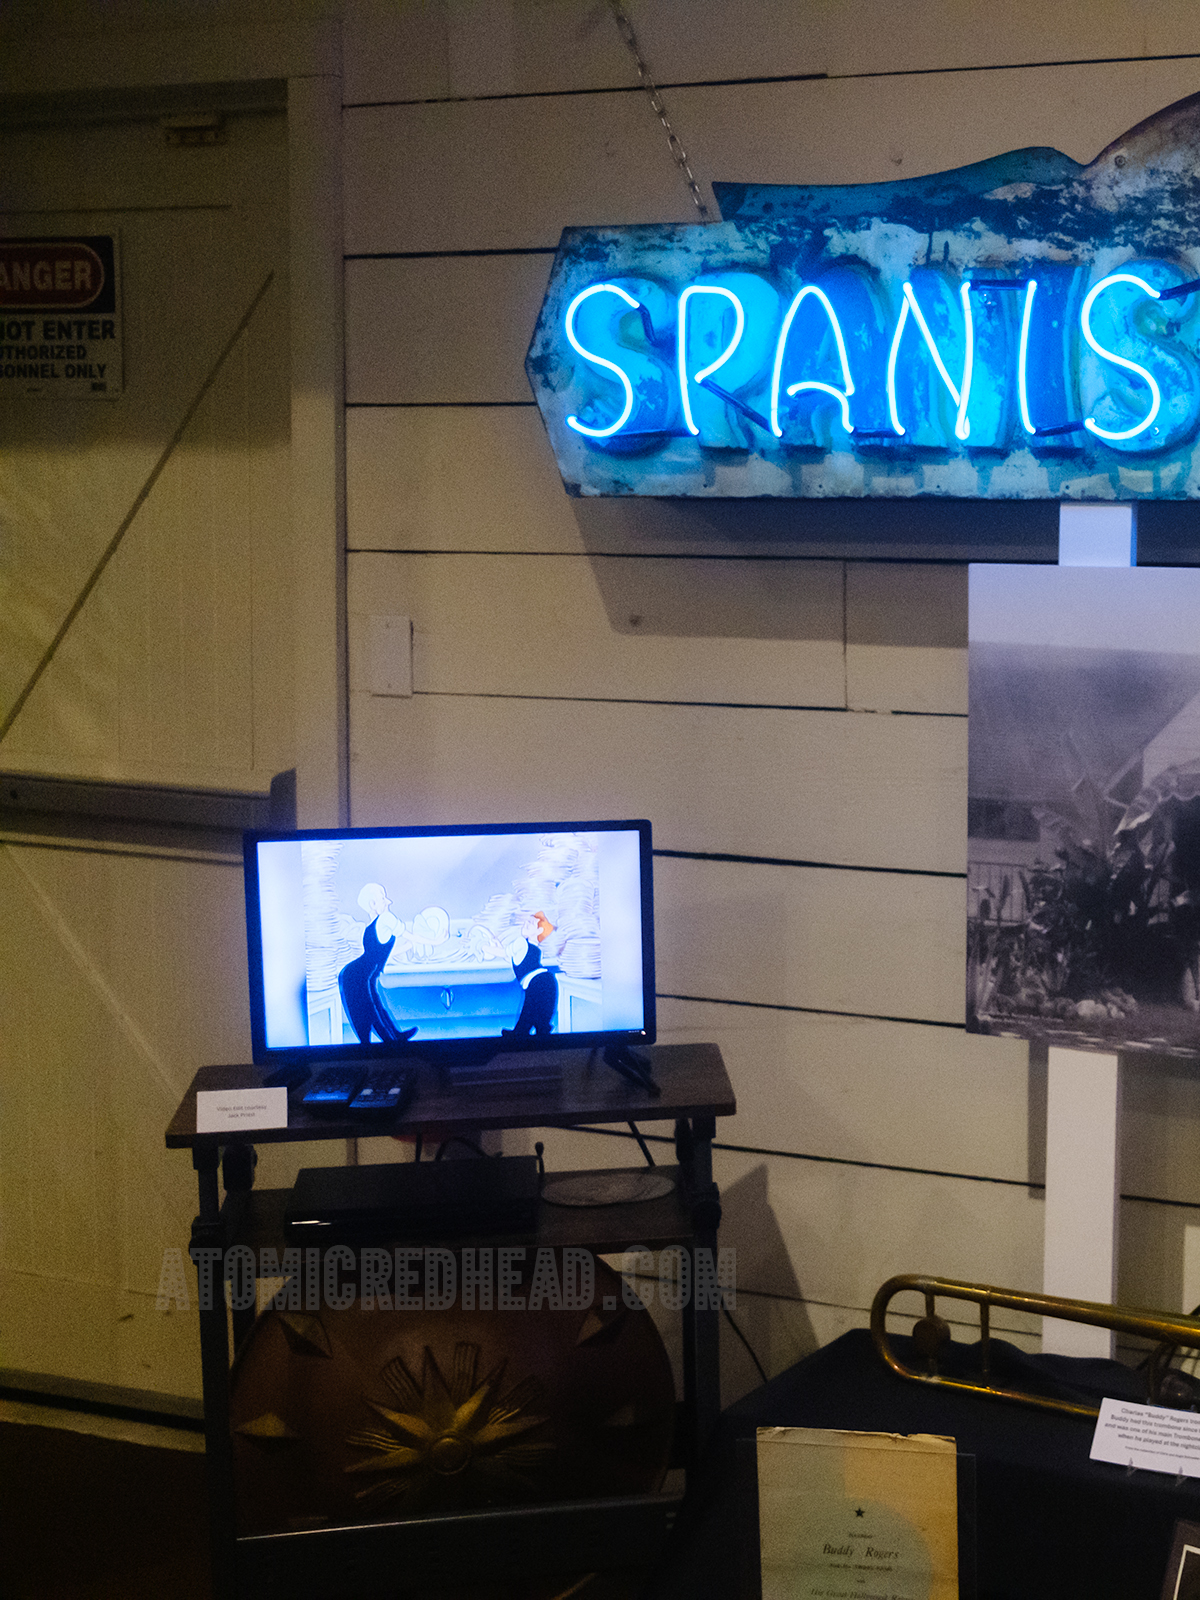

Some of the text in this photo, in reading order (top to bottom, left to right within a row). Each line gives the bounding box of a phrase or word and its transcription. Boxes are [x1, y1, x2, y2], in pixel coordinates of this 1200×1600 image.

[42, 319, 116, 341] ENTER
[65, 364, 107, 378] ONLY
[822, 1543, 899, 1560] Buddy Rogers
